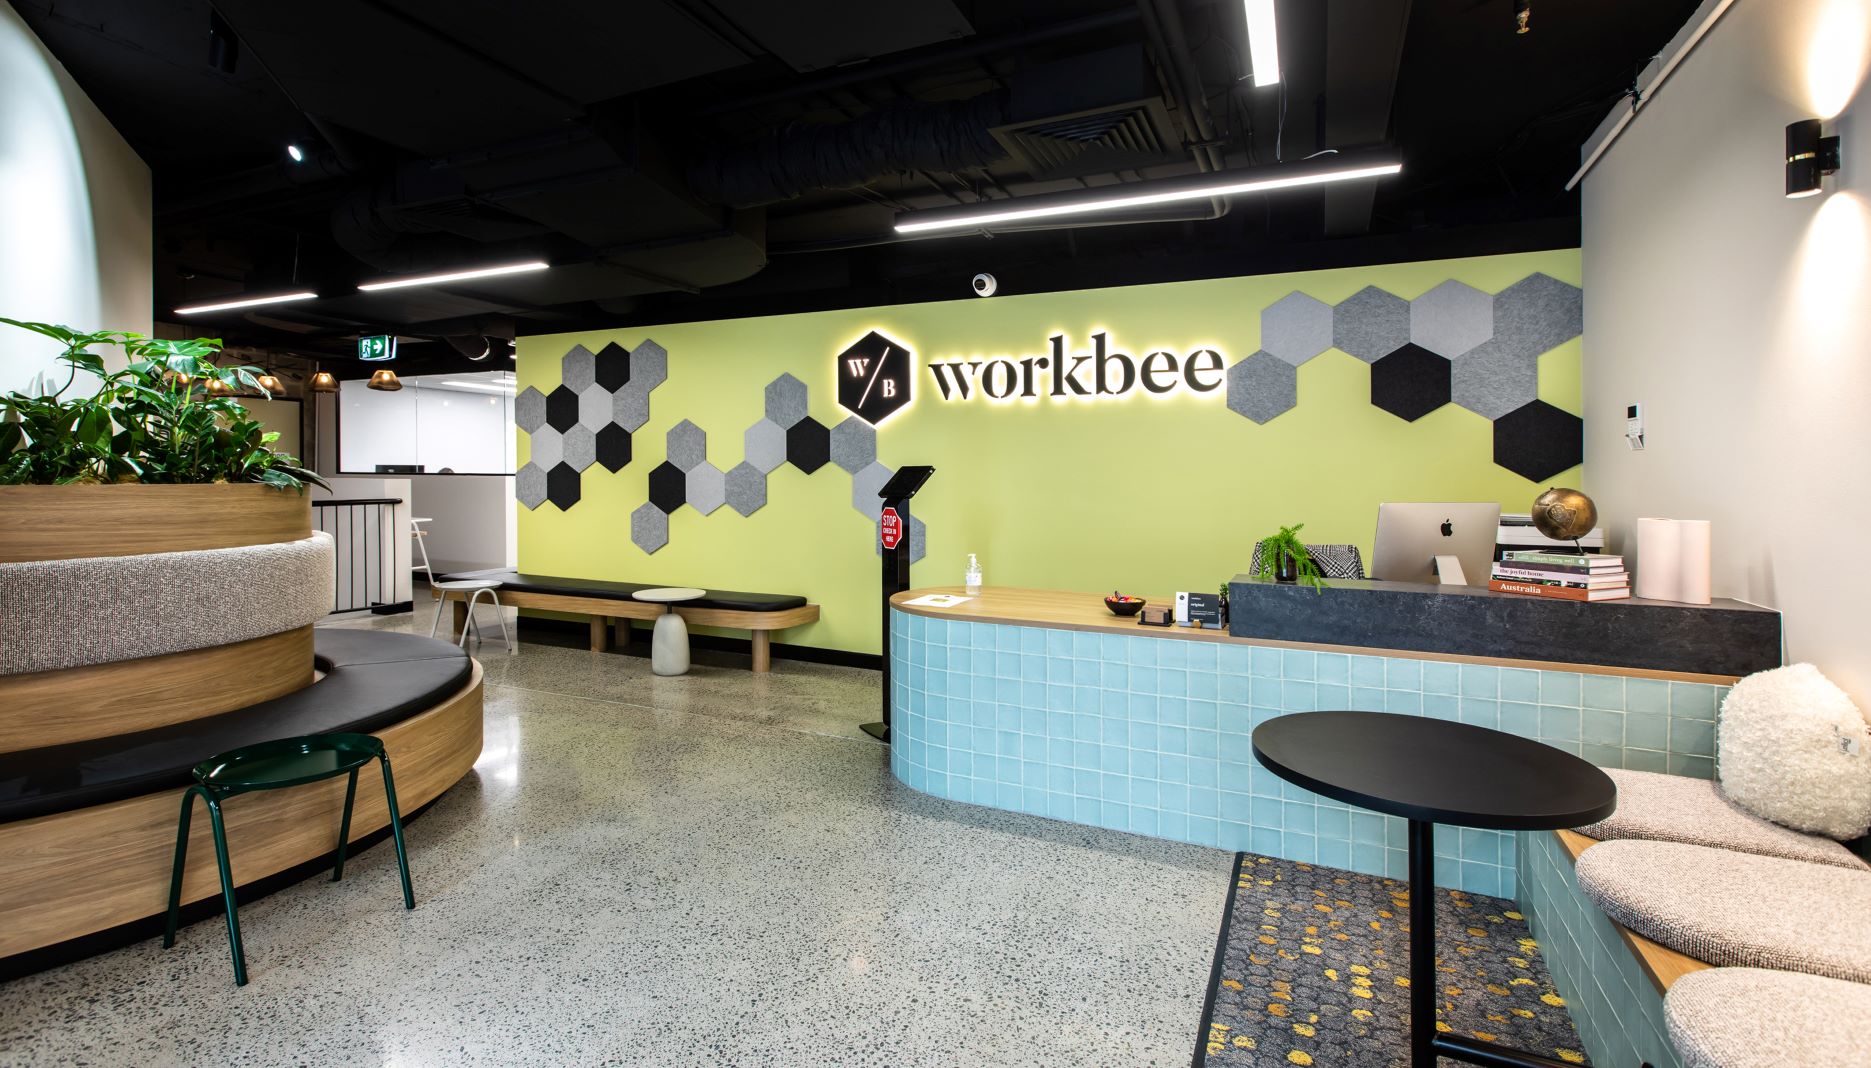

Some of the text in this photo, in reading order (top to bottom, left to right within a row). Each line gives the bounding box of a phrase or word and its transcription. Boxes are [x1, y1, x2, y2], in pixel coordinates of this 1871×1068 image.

[927, 331, 1224, 401] workbee
[883, 515, 897, 527] STOP
[1509, 569, 1527, 577] joyful
[1500, 583, 1541, 594] Australia
